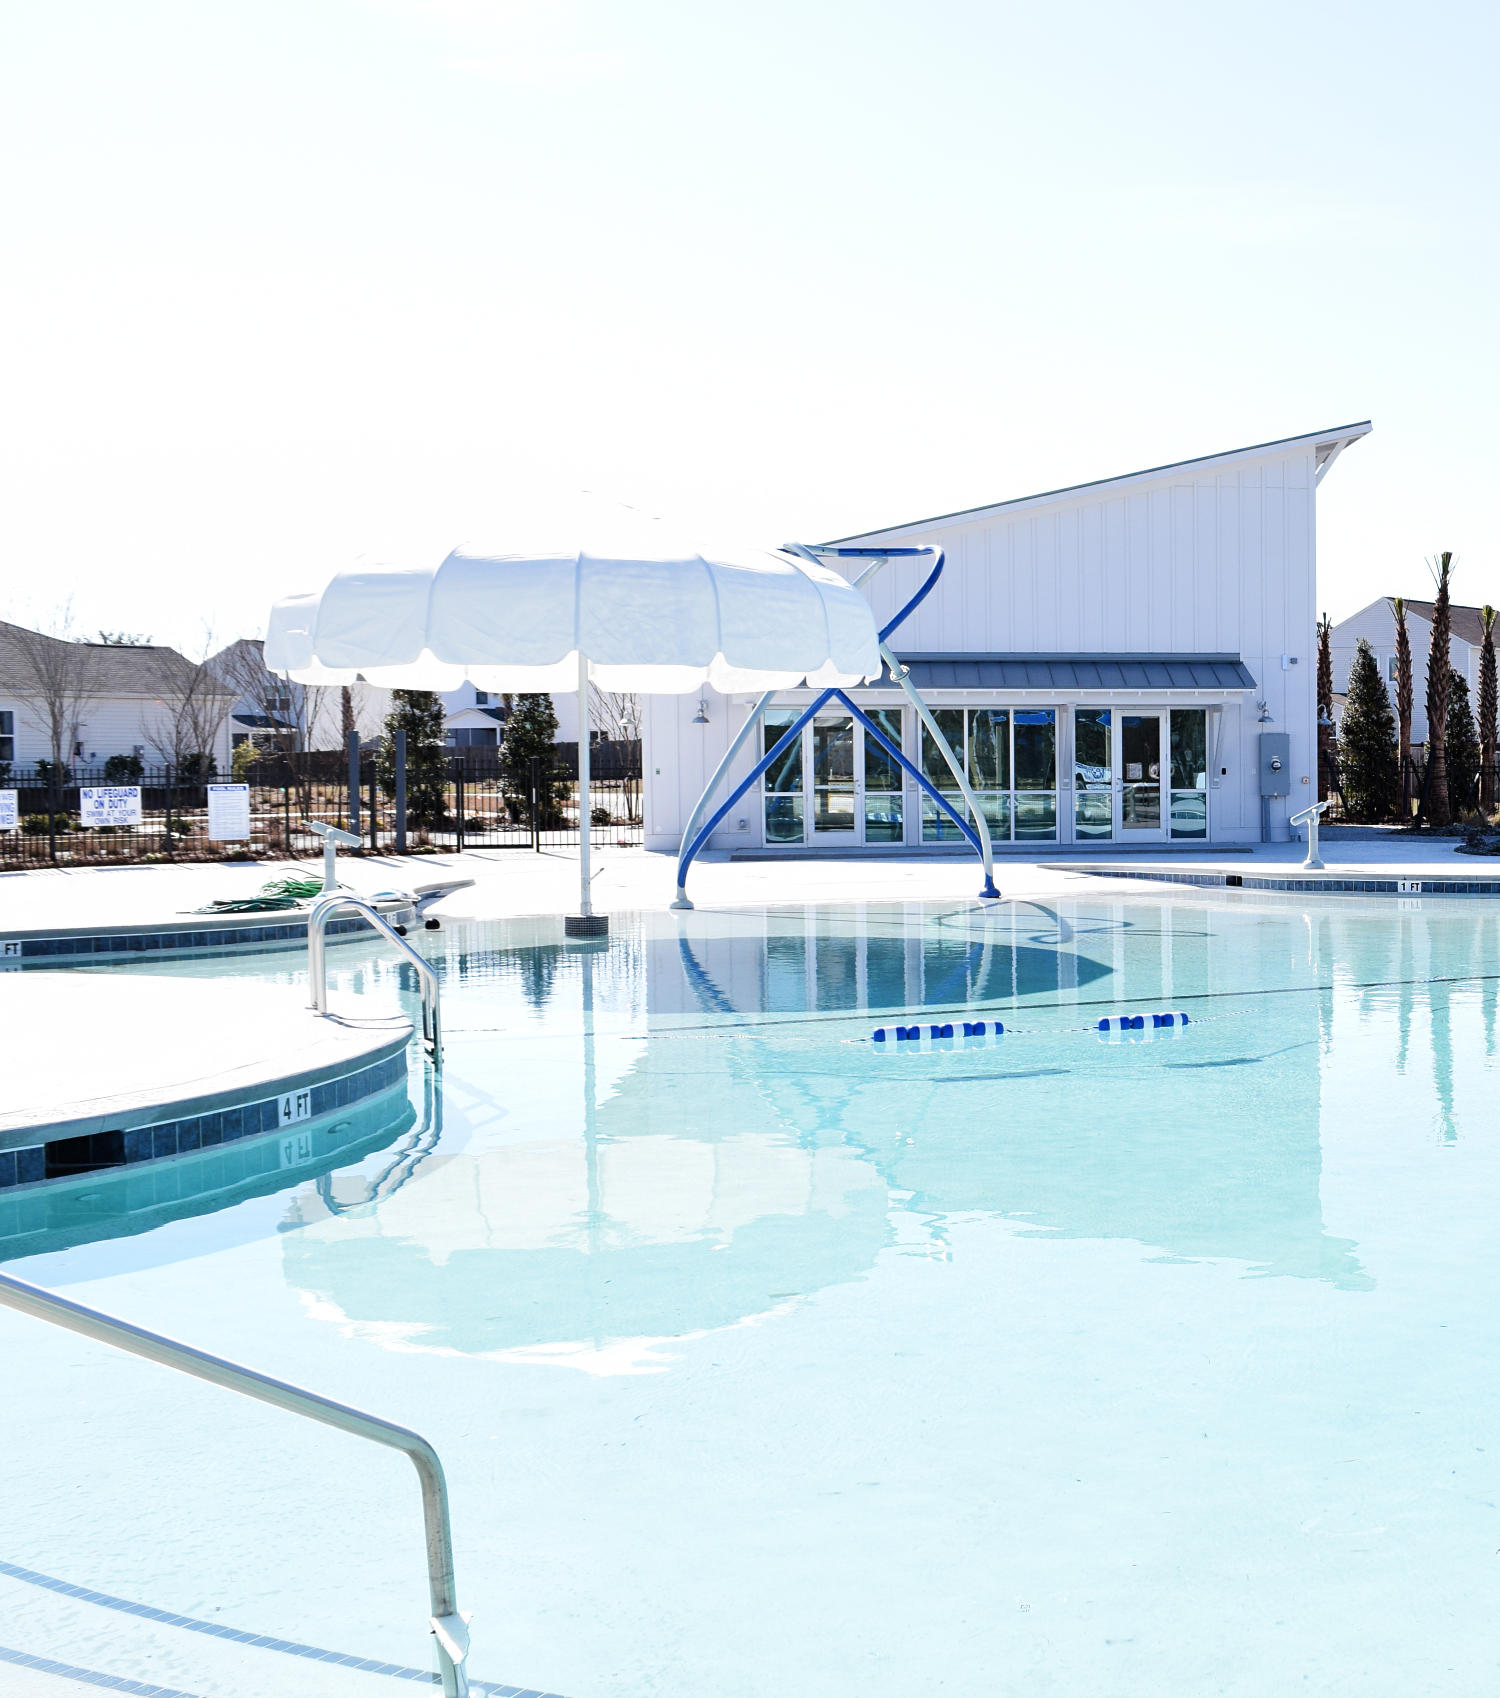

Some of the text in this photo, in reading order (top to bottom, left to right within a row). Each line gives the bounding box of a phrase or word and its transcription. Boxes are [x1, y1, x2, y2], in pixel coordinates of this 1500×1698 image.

[83, 788, 137, 799] NO LIFEGUARD
[94, 799, 127, 809] ON DUTY
[1401, 883, 1419, 891] 1 FT
[5, 943, 19, 955] FT
[284, 1093, 308, 1120] 4 FT
